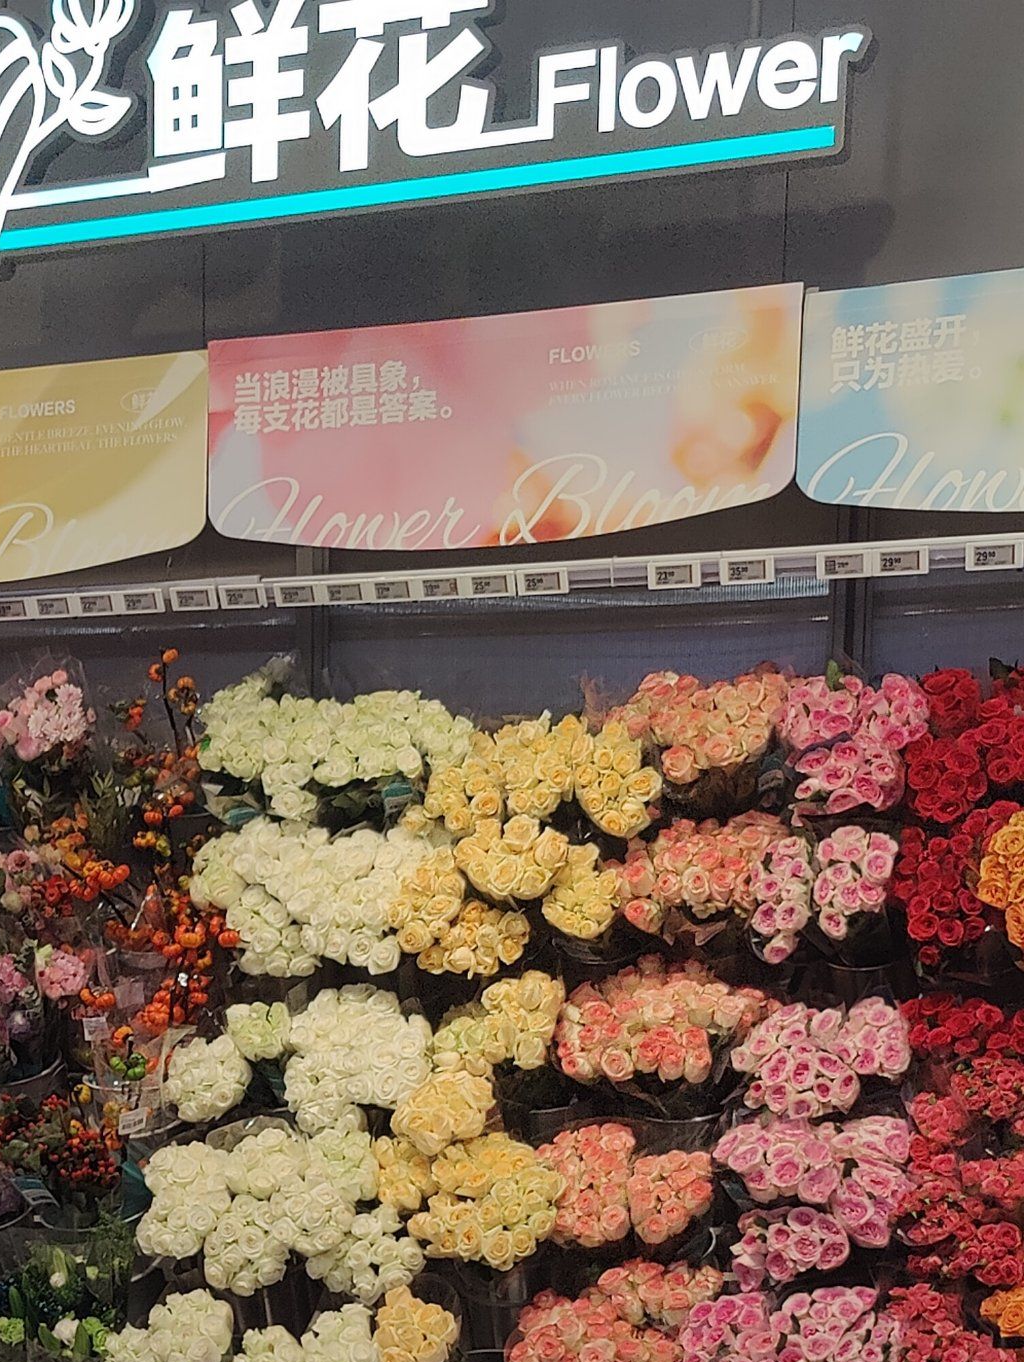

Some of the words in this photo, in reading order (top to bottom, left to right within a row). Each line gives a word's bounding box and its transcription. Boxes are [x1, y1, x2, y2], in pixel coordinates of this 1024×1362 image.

[147, 0, 524, 187] 鲜花
[535, 27, 863, 140] Flower
[548, 340, 641, 365] FLOWERS
[234, 361, 420, 404] 当浪漫被具象，
[0, 399, 76, 420] FLOWERS
[234, 391, 452, 435] 每支花都是答案。
